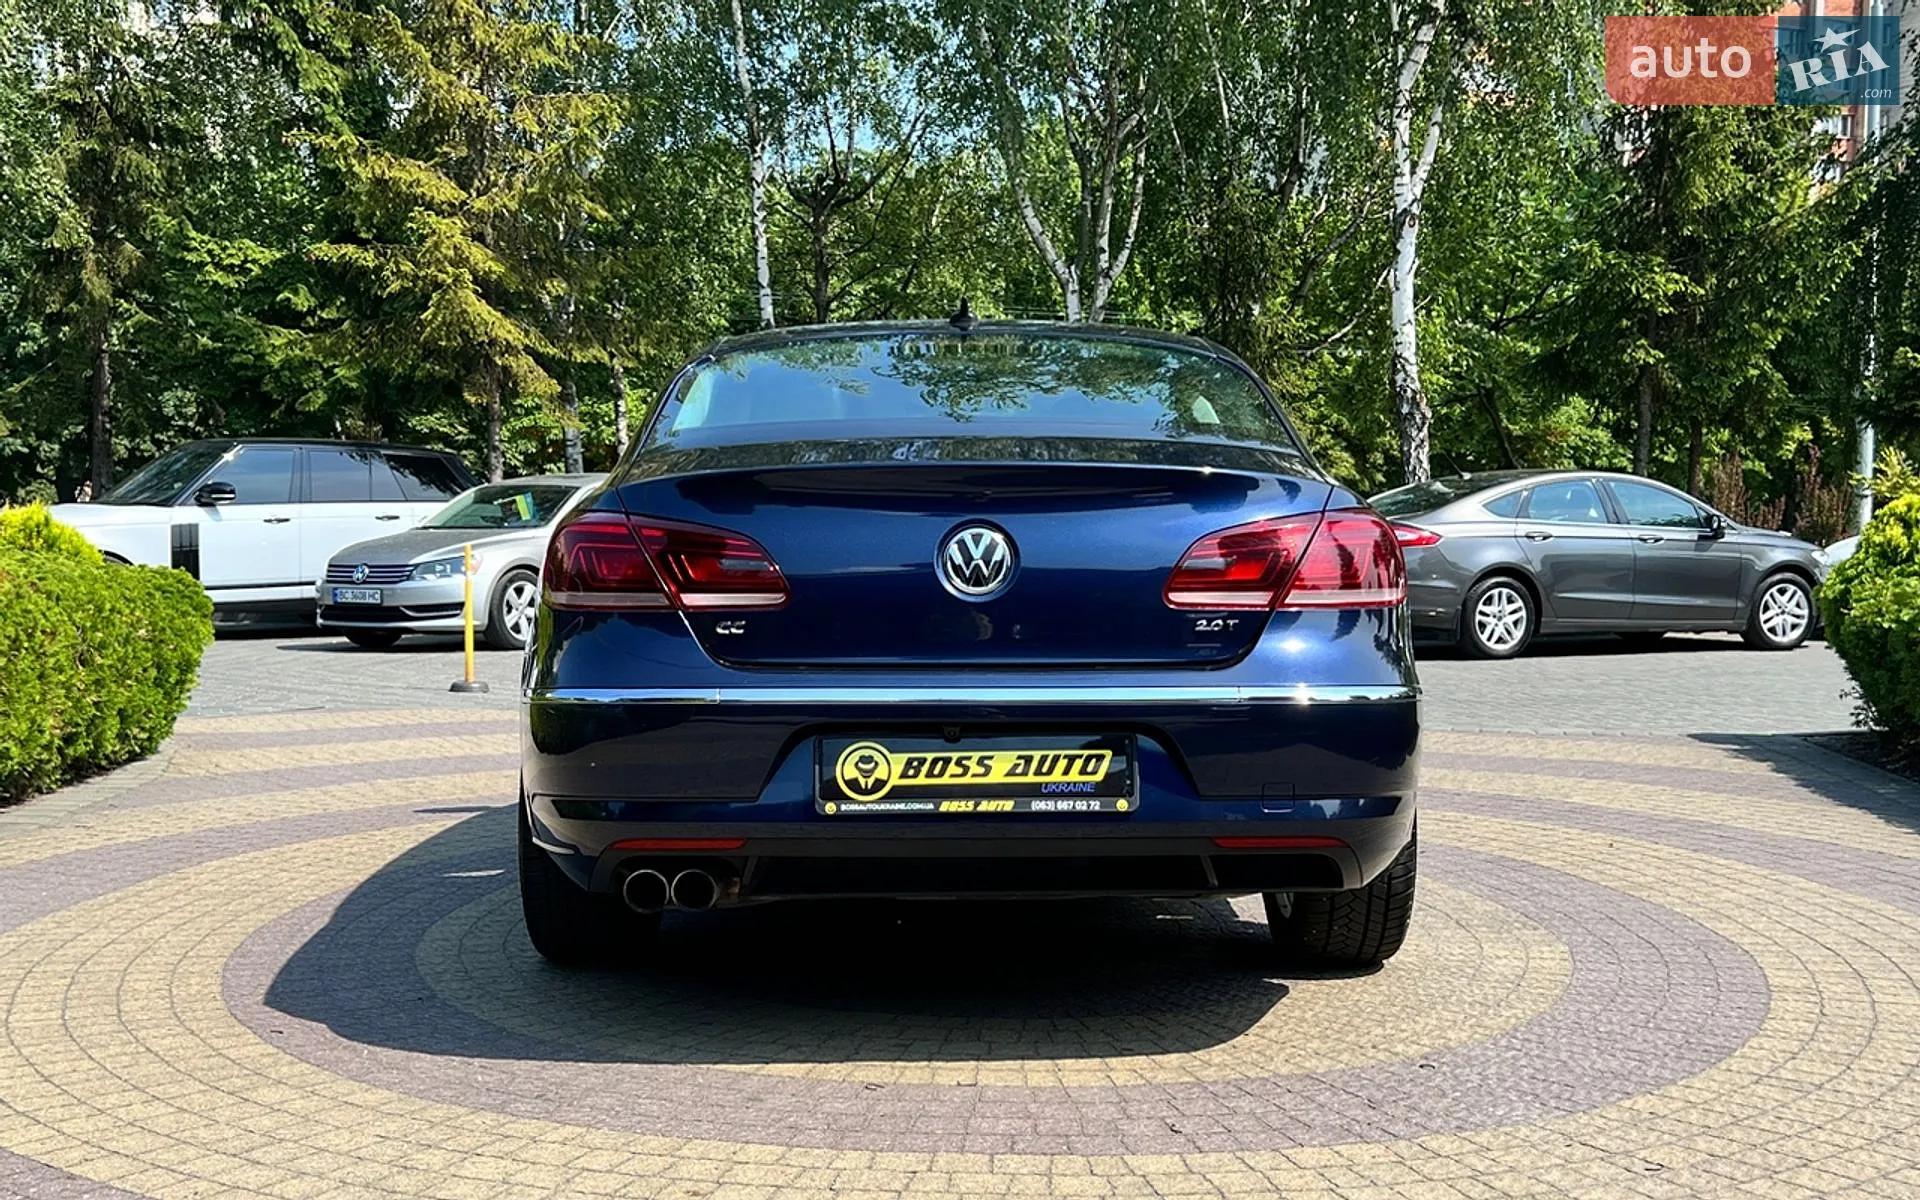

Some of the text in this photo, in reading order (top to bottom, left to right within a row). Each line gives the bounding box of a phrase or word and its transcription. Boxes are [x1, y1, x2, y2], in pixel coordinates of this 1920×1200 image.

[898, 753, 1107, 779] BOSS AUTO
[1041, 782, 1096, 793] UKRAINE
[938, 800, 1016, 812] BOSS AUTO
[1031, 800, 1101, 811] (063) 667 02 72
